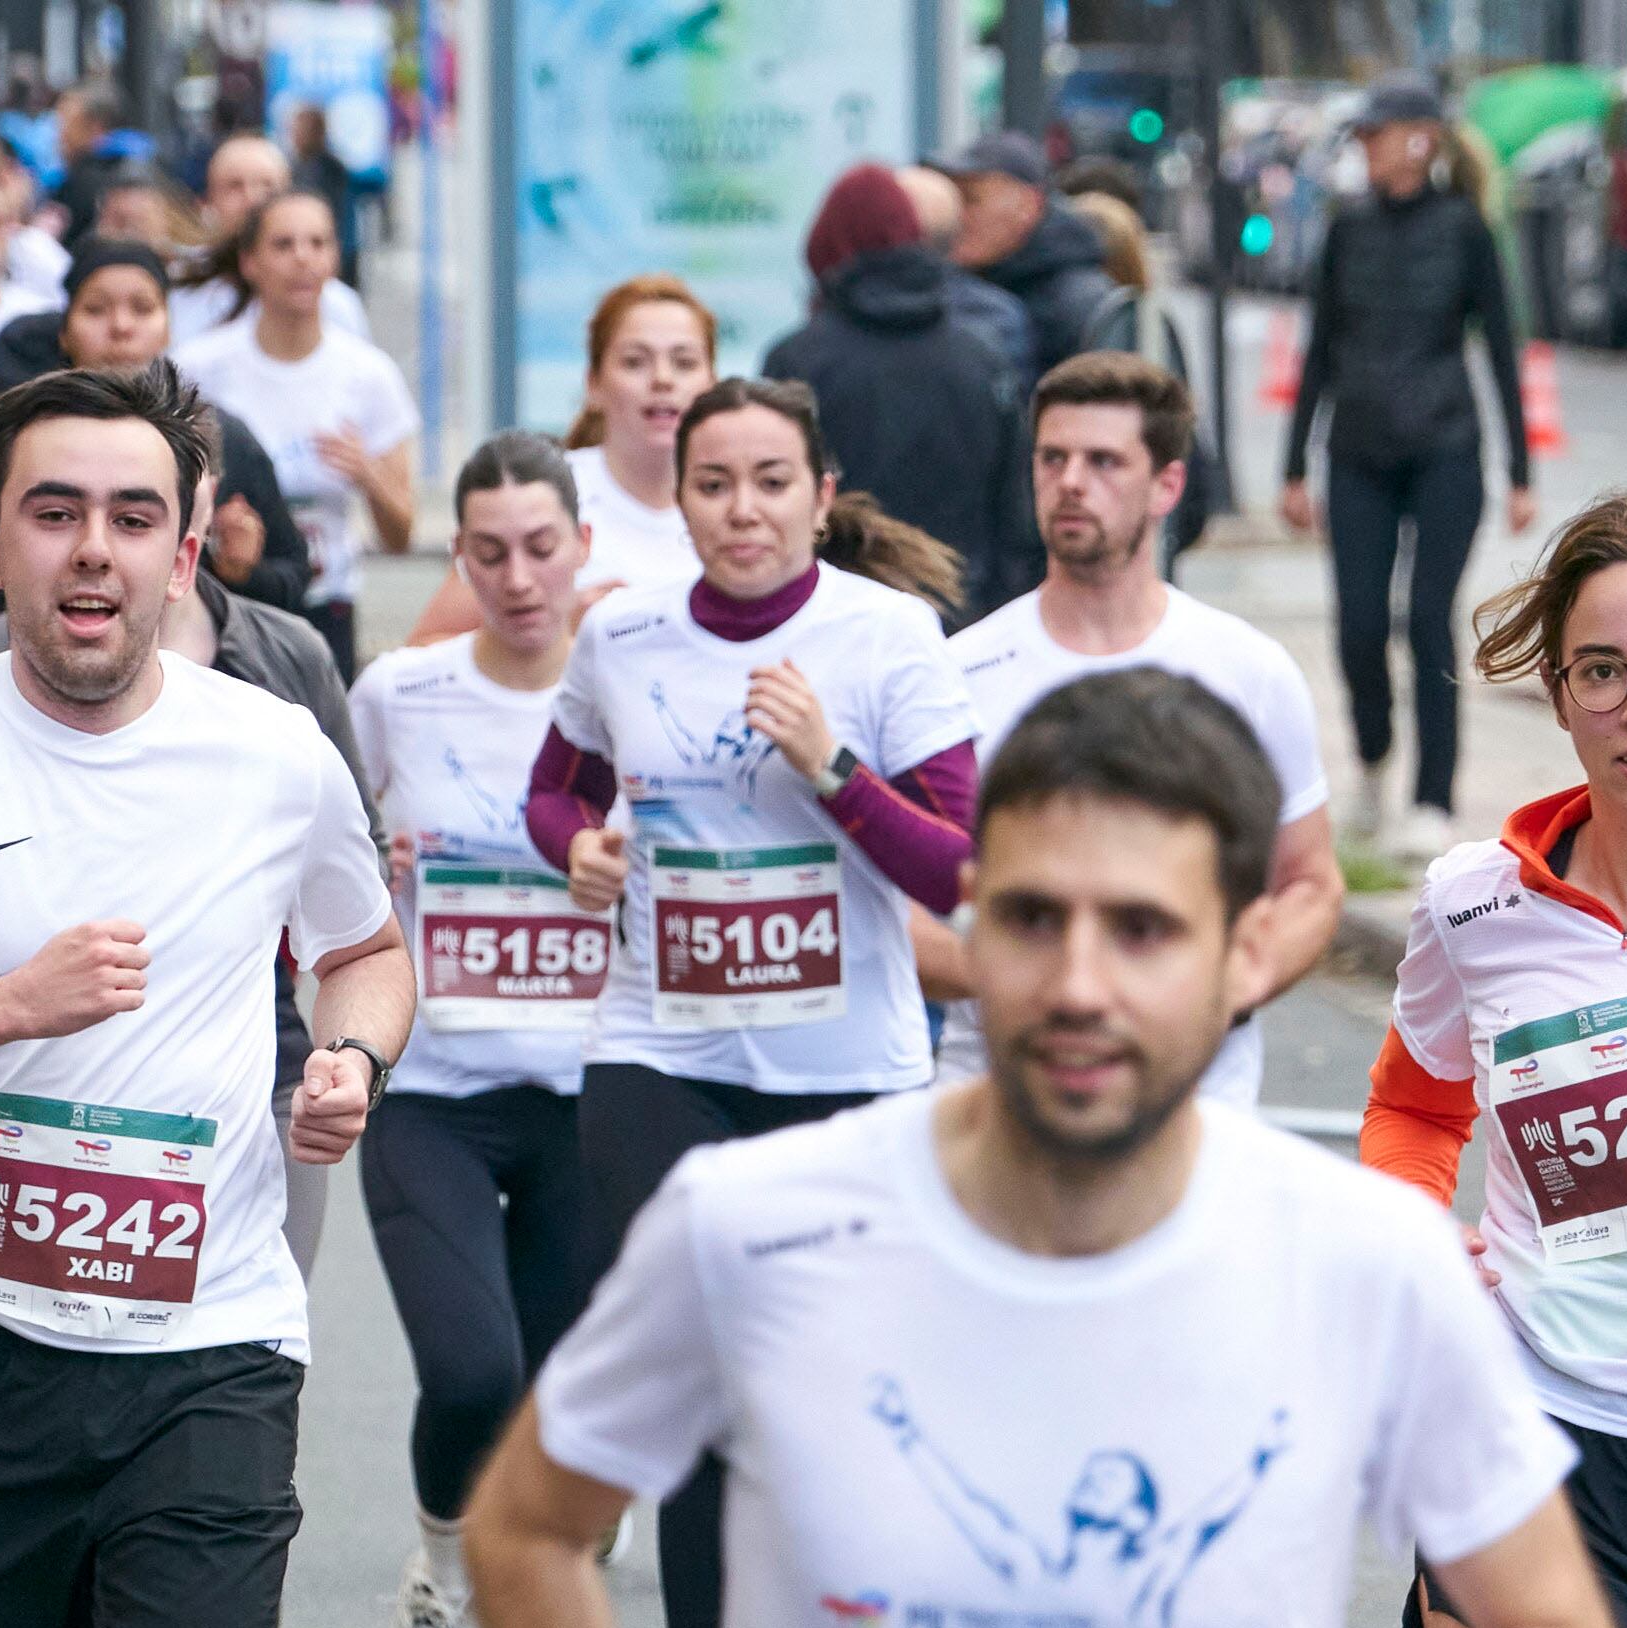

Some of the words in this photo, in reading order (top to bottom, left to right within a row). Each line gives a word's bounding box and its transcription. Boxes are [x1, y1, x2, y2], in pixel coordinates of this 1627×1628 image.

[1447, 896, 1499, 928] luanvi
[690, 907, 838, 965] 5104
[461, 926, 607, 976] 5158
[496, 975, 574, 996] MARTA
[724, 962, 803, 986] LAURA
[11, 1183, 200, 1260] 5242
[66, 1257, 134, 1284] XABI
[53, 1300, 91, 1314] renfe
